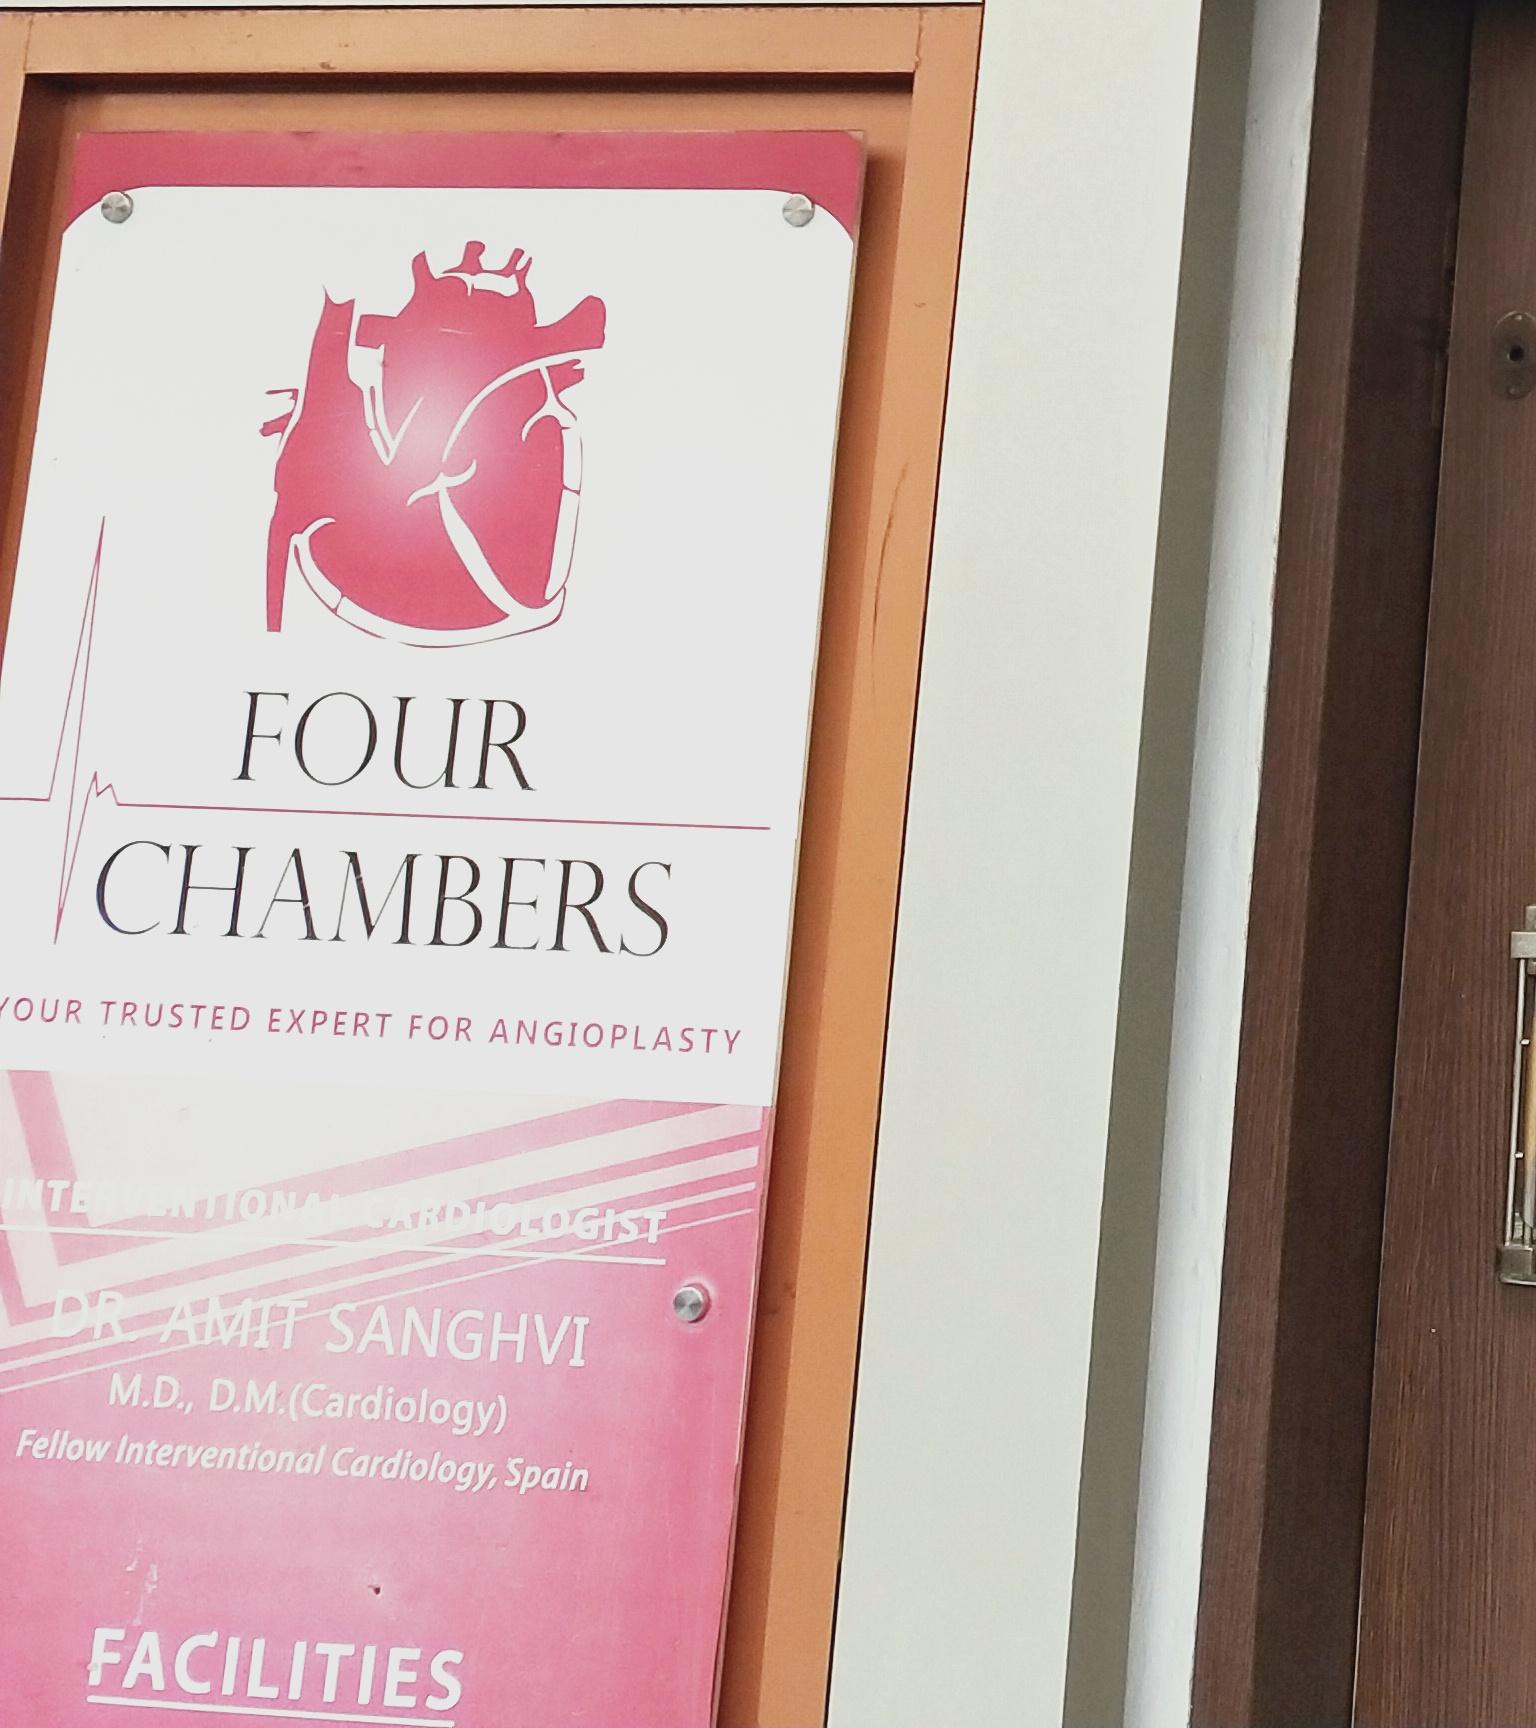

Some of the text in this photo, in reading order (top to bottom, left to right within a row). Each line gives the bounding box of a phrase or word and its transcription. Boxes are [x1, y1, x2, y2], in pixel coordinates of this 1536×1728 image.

[232, 691, 537, 791] FOUR
[96, 840, 673, 957] CHAMBERS
[100, 1000, 251, 1032] TRUSTED
[267, 1009, 393, 1040] EXPERT
[408, 1015, 473, 1044] FOR
[489, 1018, 742, 1056] ANGIOPLASTY
[364, 1197, 667, 1244] CARDIOLOGIST
[52, 1289, 590, 1367] DR. AMIT SANGHVI
[108, 1374, 194, 1414] M.D.,
[16, 1429, 590, 1495] Fellow Interventional Cardiology, Spain
[87, 1627, 466, 1712] FACILITIES
